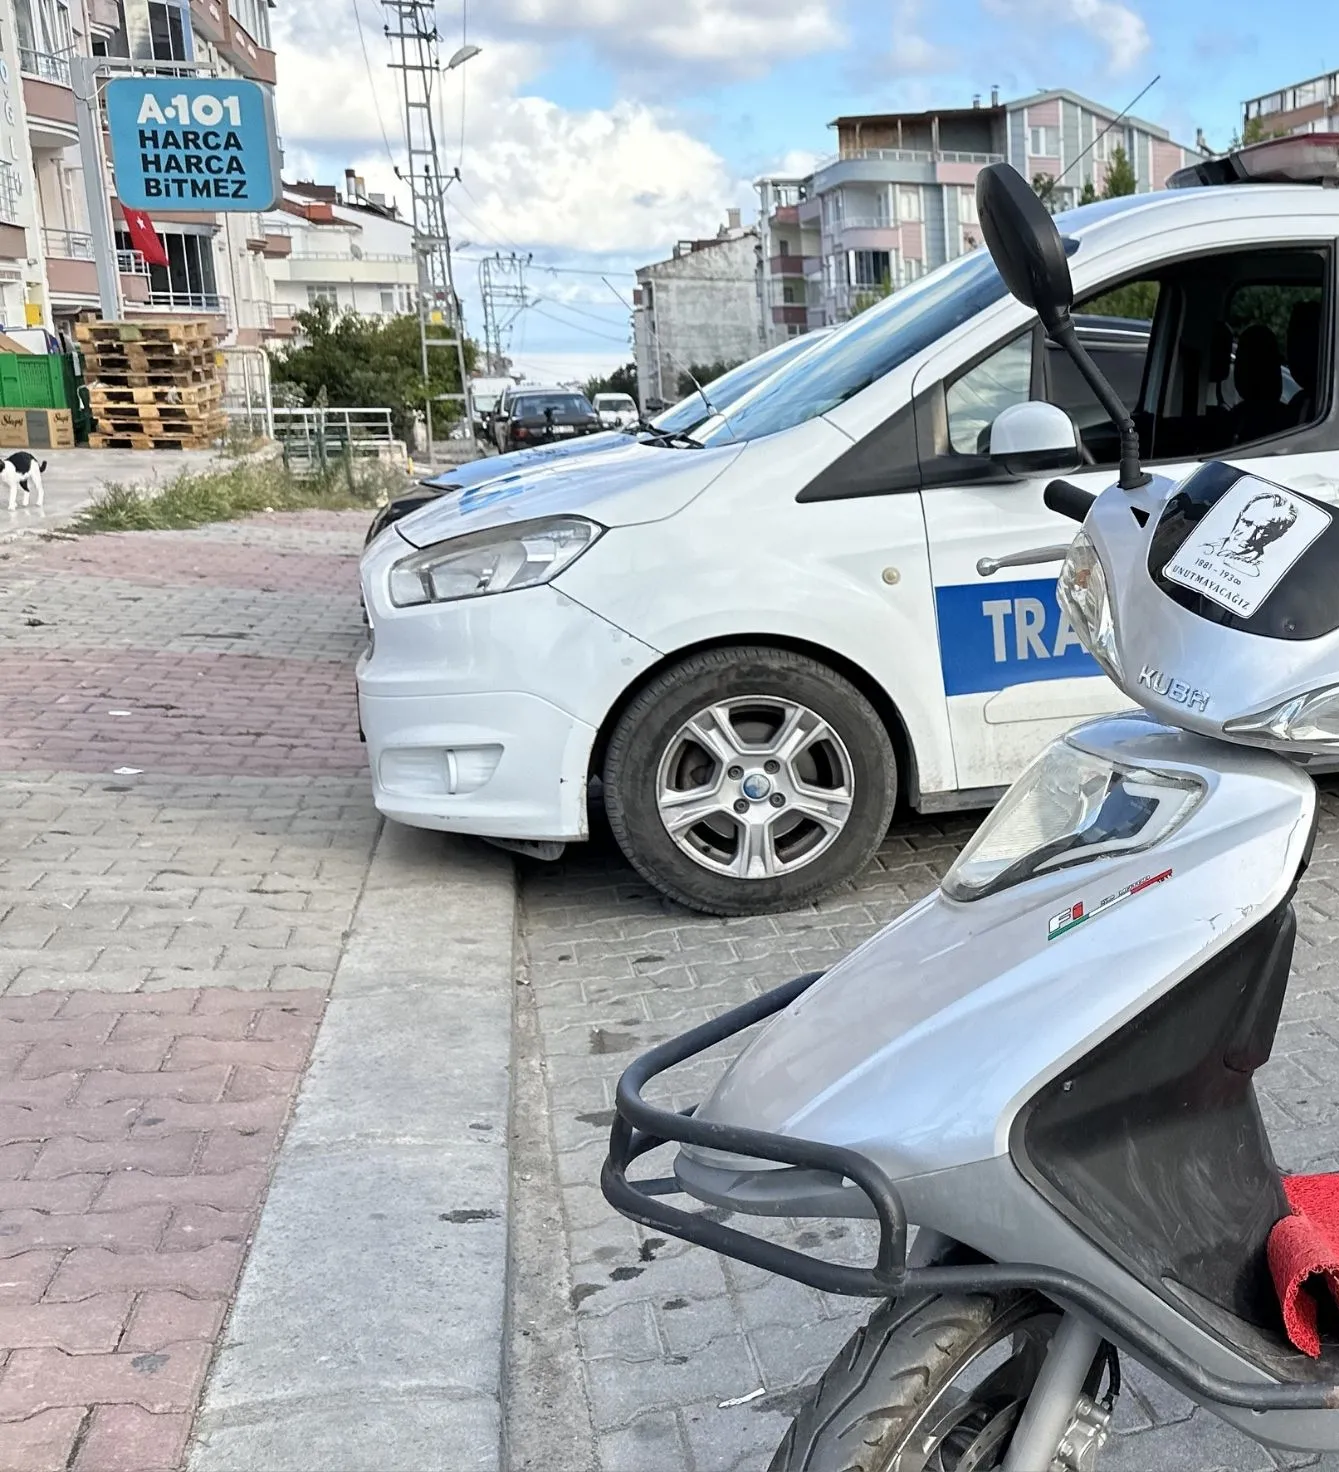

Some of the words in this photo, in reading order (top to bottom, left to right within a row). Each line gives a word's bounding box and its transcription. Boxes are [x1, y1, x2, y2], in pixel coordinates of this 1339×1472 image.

[138, 129, 244, 151] HARCA
[141, 153, 246, 175] HARCA
[1195, 557, 1213, 572] 1881
[1172, 564, 1250, 610] UNUTMAYACAĞIZ
[982, 597, 1090, 663] TRA
[1138, 664, 1210, 712] KUBA
